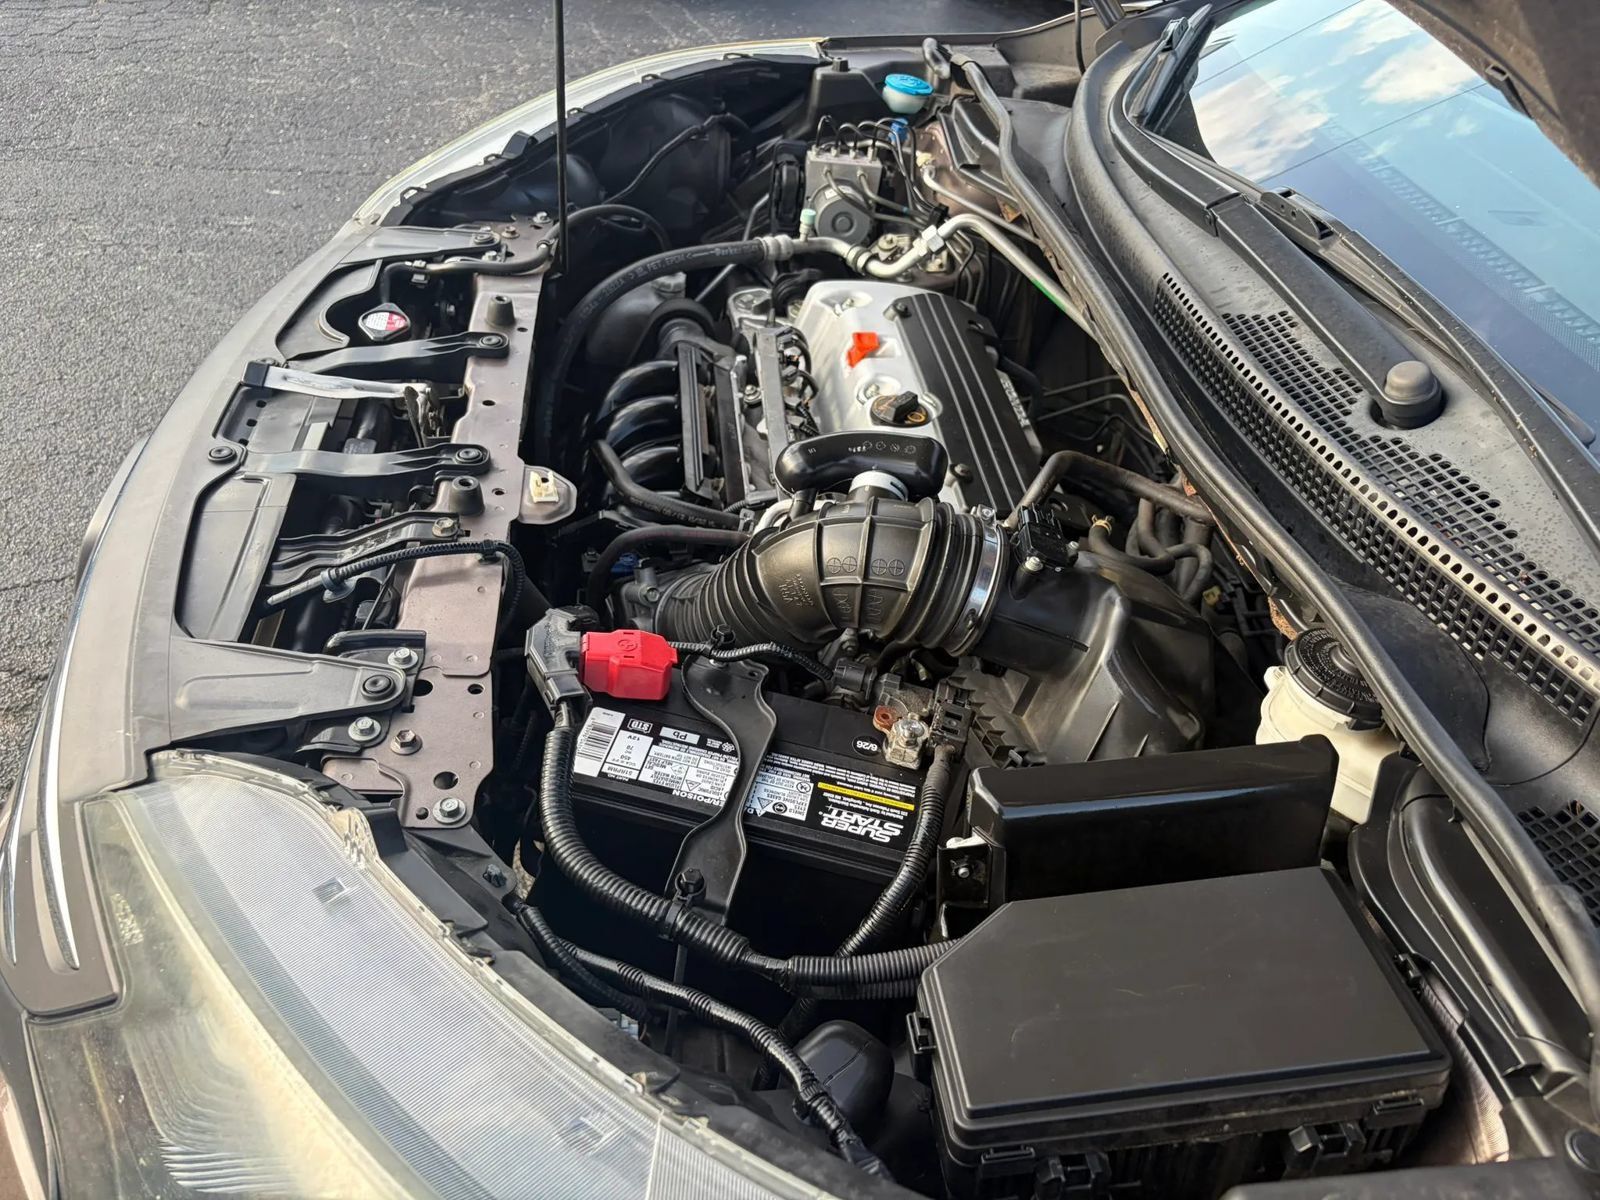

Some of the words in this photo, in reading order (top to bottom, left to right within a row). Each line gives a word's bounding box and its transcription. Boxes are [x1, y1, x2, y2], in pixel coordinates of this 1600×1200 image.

[672, 730, 687, 740] Pb
[856, 739, 877, 751] 6/26
[821, 816, 891, 843] SUPER
[825, 807, 904, 837] START
